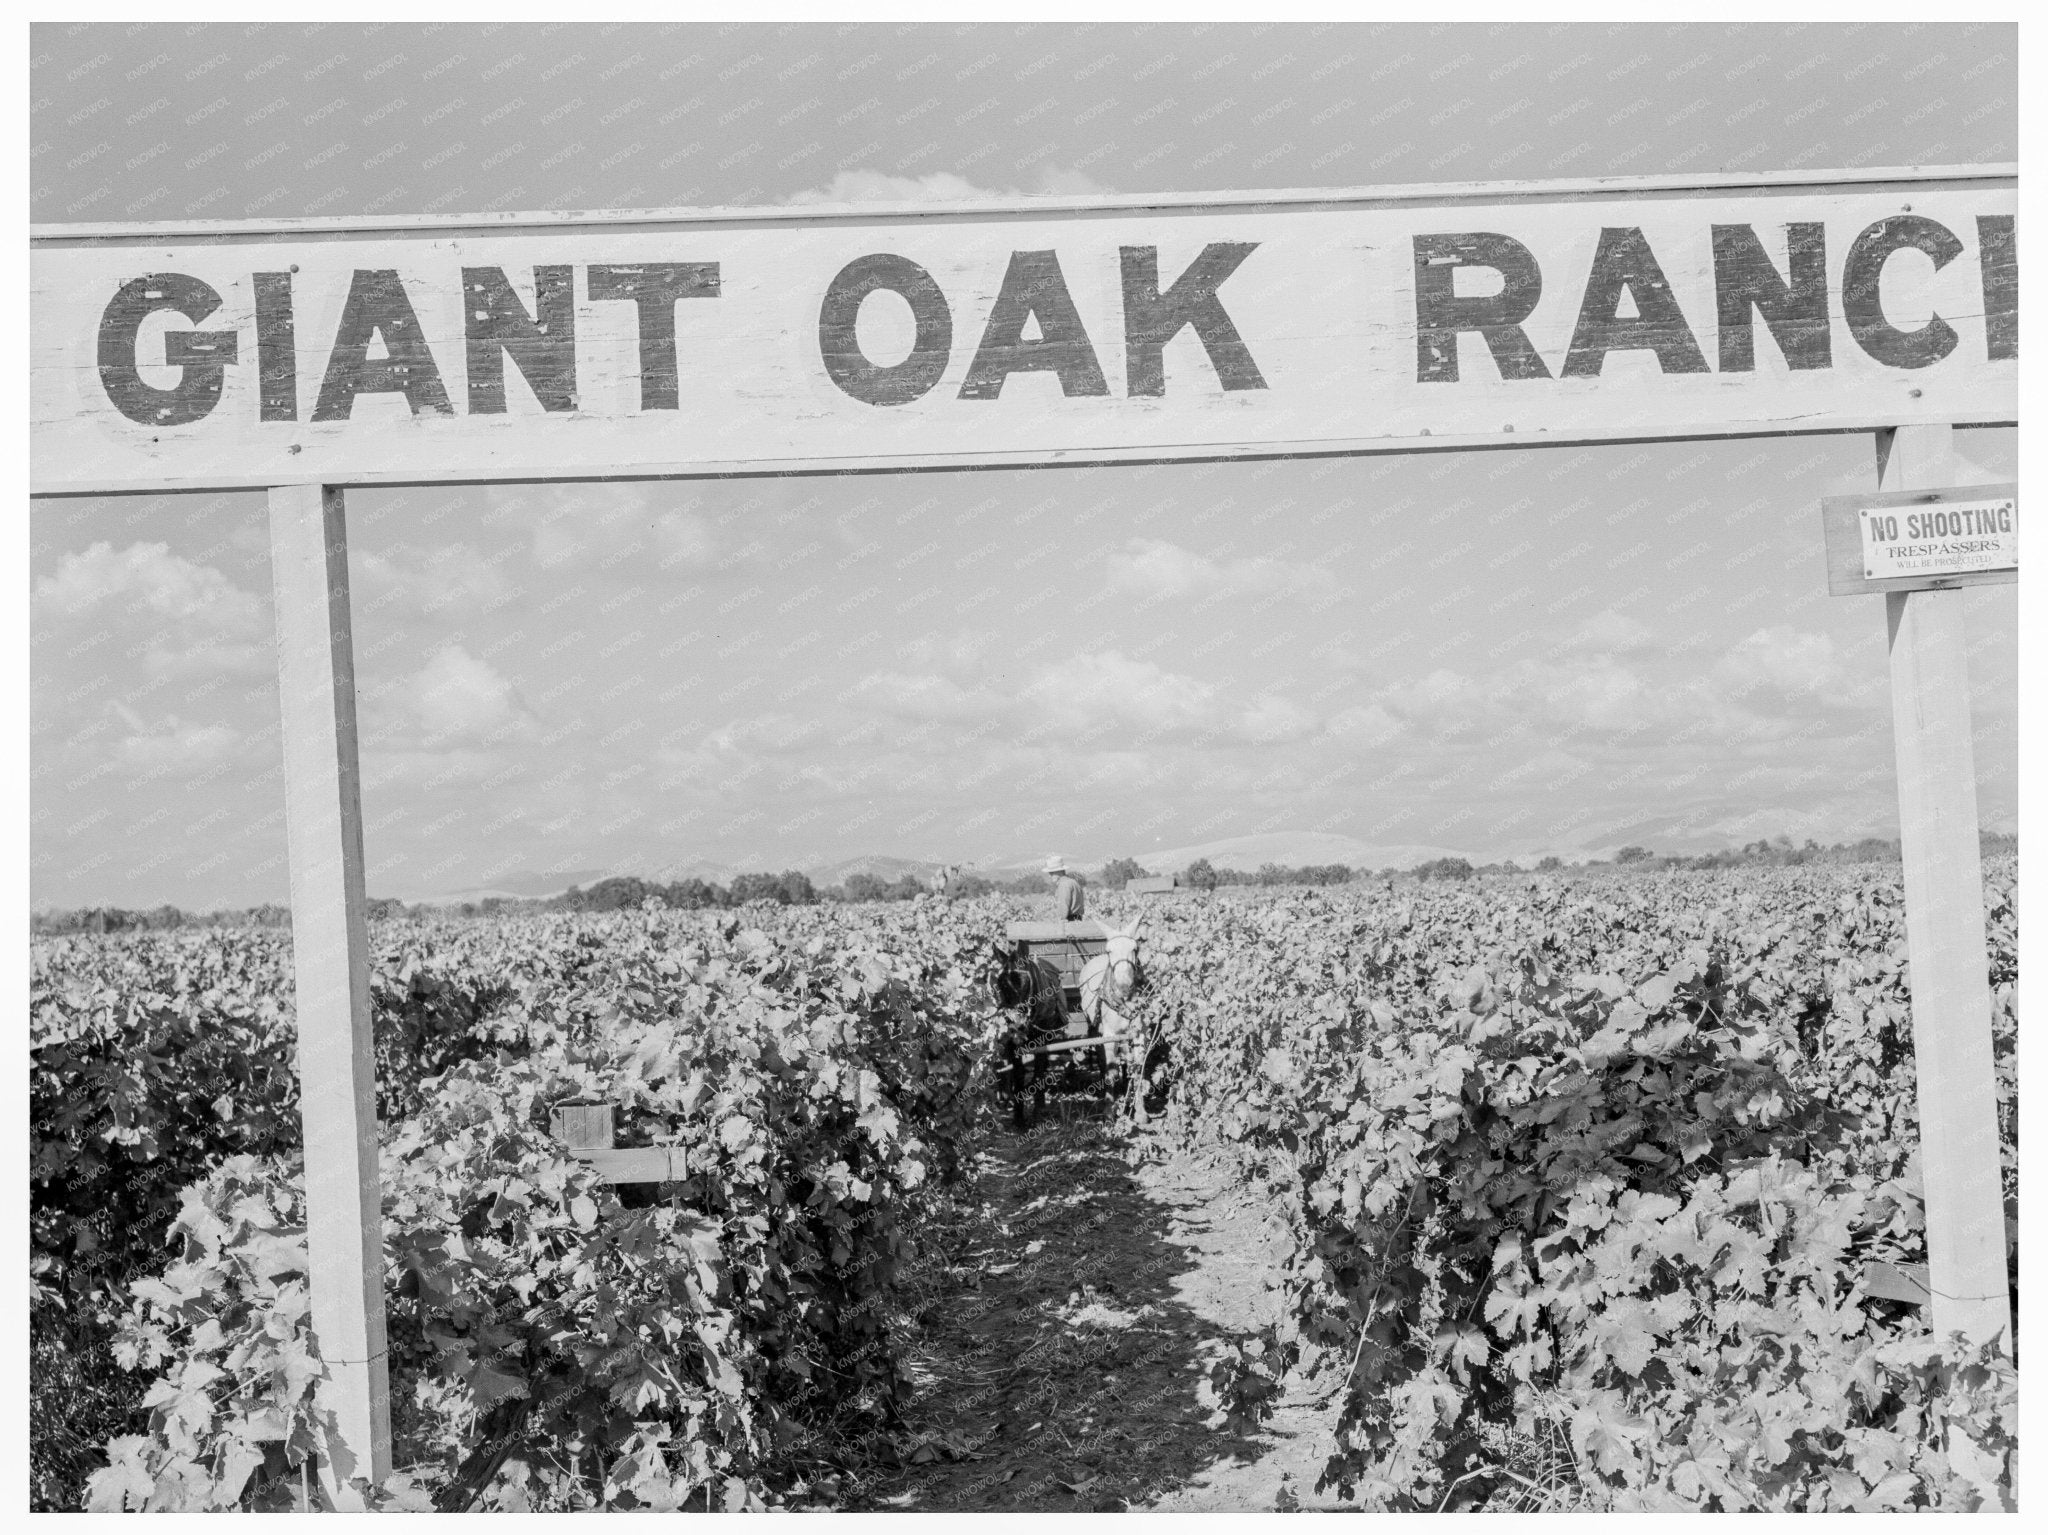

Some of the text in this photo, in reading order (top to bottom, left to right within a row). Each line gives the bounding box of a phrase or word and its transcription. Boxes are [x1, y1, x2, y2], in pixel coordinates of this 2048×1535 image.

[97, 262, 721, 426] GIANT
[819, 242, 1269, 406] OAK
[1870, 508, 2011, 541] NO SHOOTING
[1886, 540, 2000, 558] TRESPASSERS
[1897, 560, 1919, 568] WILL
[1921, 558, 1933, 568] BE
